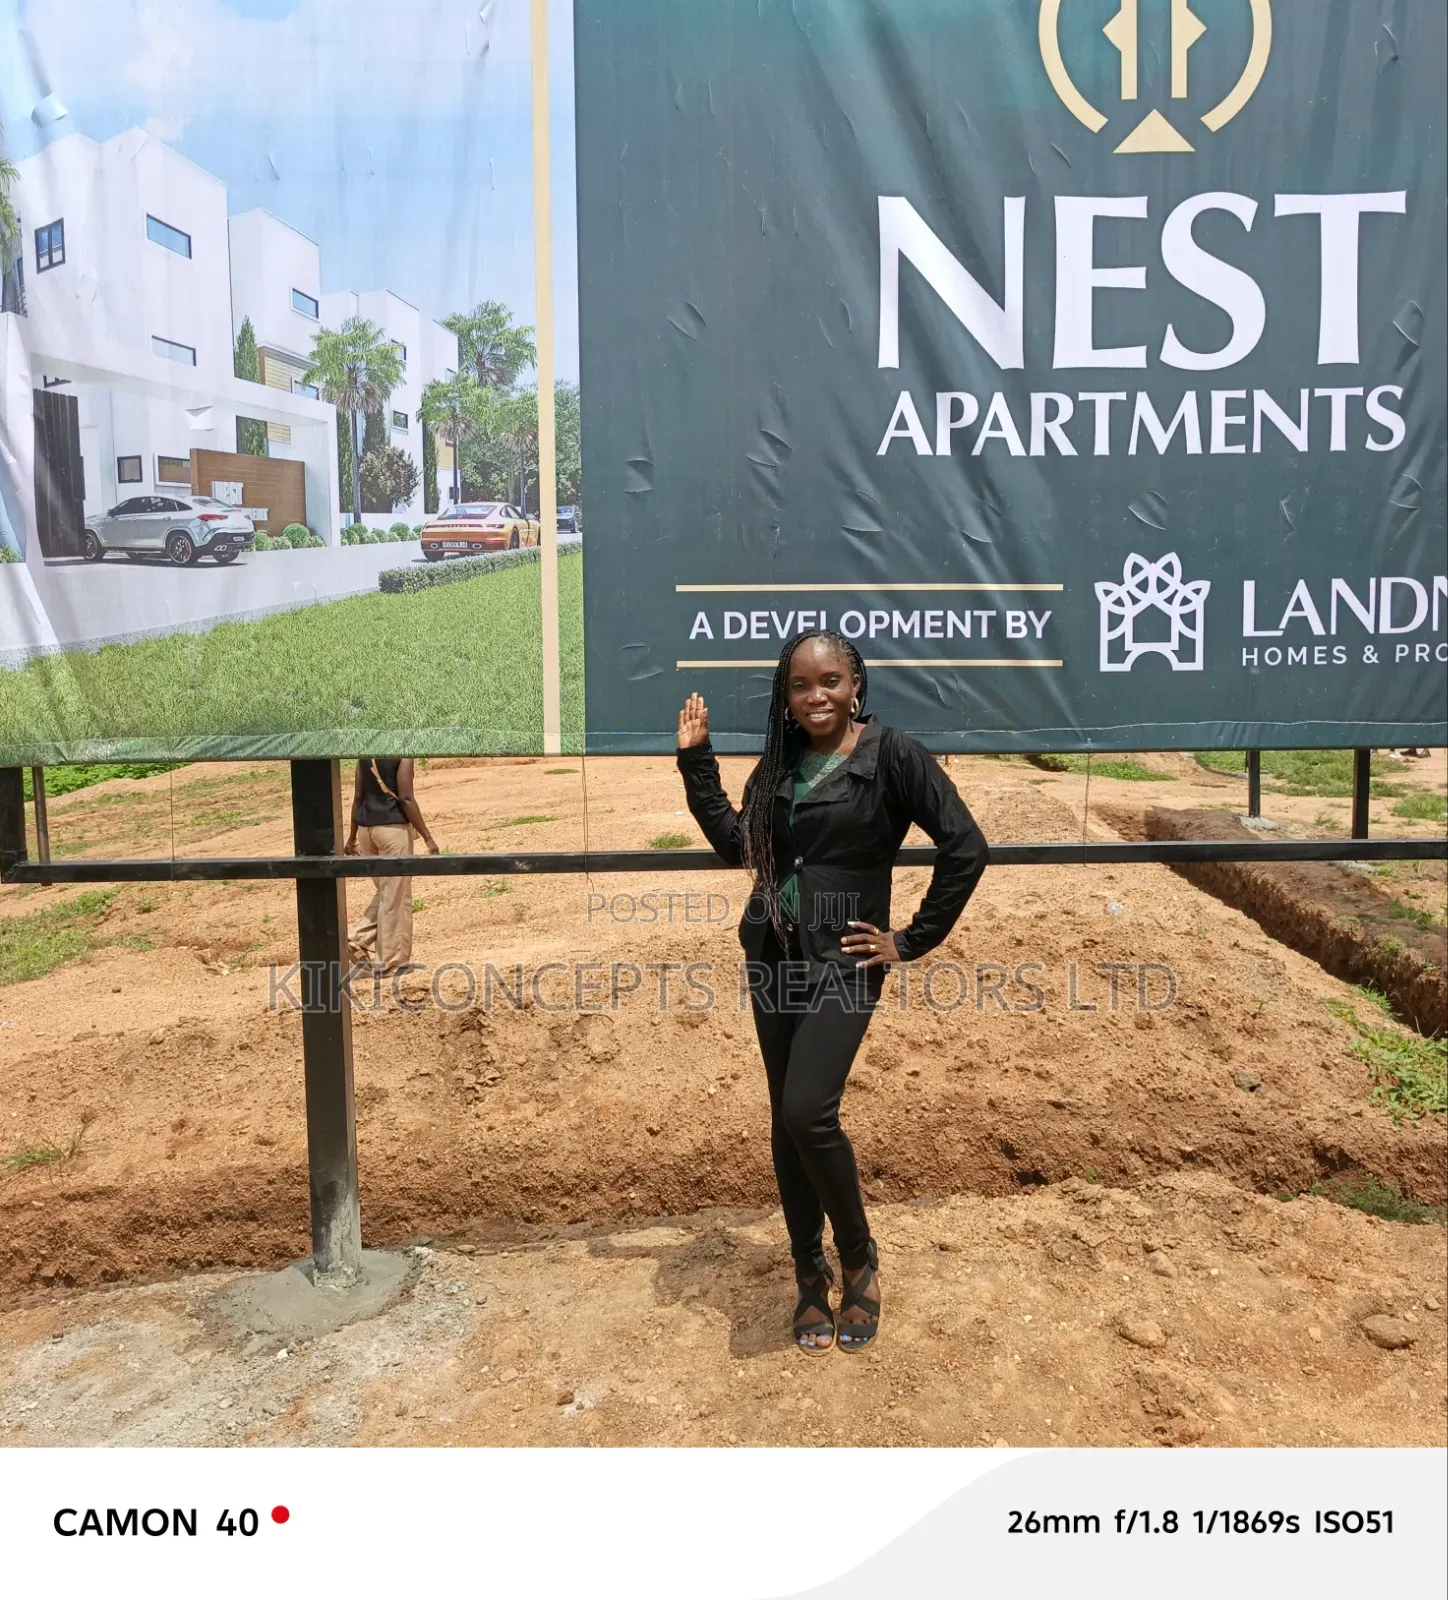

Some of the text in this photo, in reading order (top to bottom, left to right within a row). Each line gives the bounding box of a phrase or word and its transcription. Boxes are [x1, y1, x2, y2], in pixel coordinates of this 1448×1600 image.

[877, 190, 1407, 371] NEST
[876, 384, 1407, 457] APARTMENTS
[689, 611, 714, 640] A
[1005, 609, 1053, 639] BY
[1242, 646, 1348, 666] HOMES
[1362, 645, 1380, 664] &
